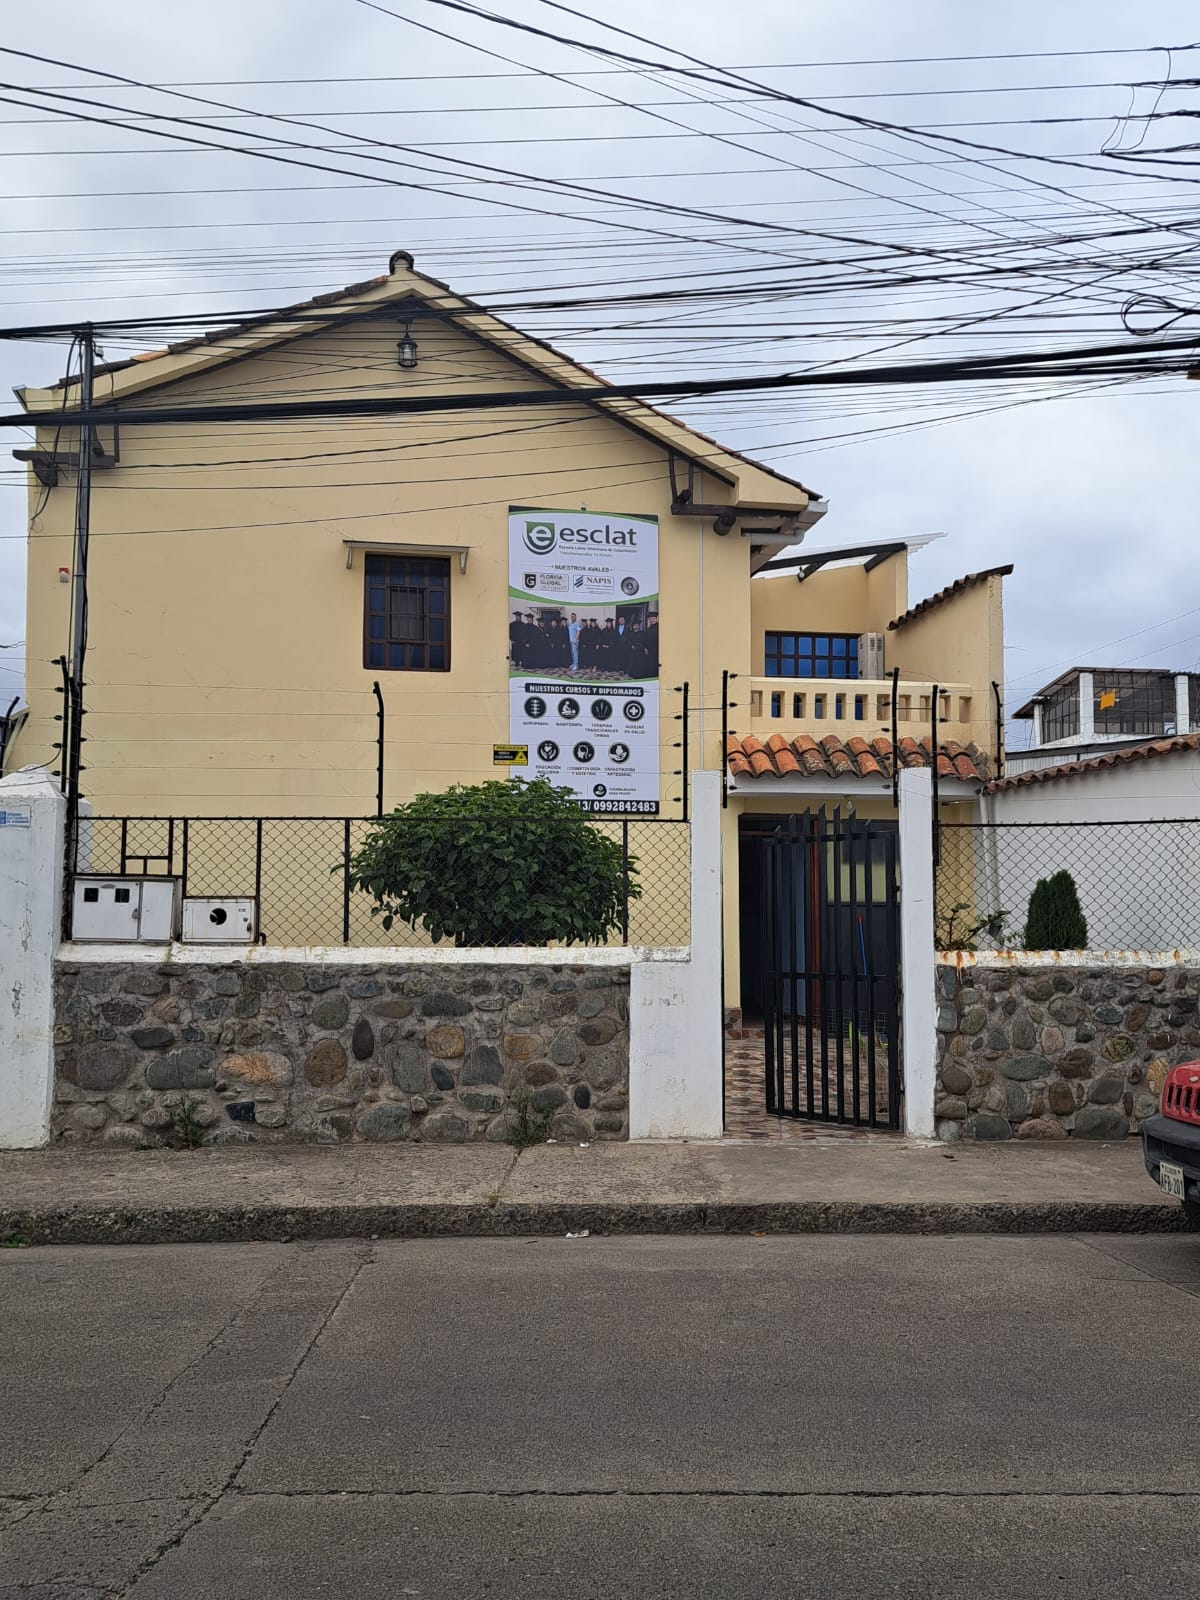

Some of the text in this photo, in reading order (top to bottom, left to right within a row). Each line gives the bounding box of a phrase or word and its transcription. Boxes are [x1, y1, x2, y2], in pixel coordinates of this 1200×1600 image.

[559, 525, 638, 546] esclat
[586, 576, 612, 584] NAPIS
[598, 687, 641, 696] DIPLOMADOS
[593, 801, 656, 812] 0992842483
